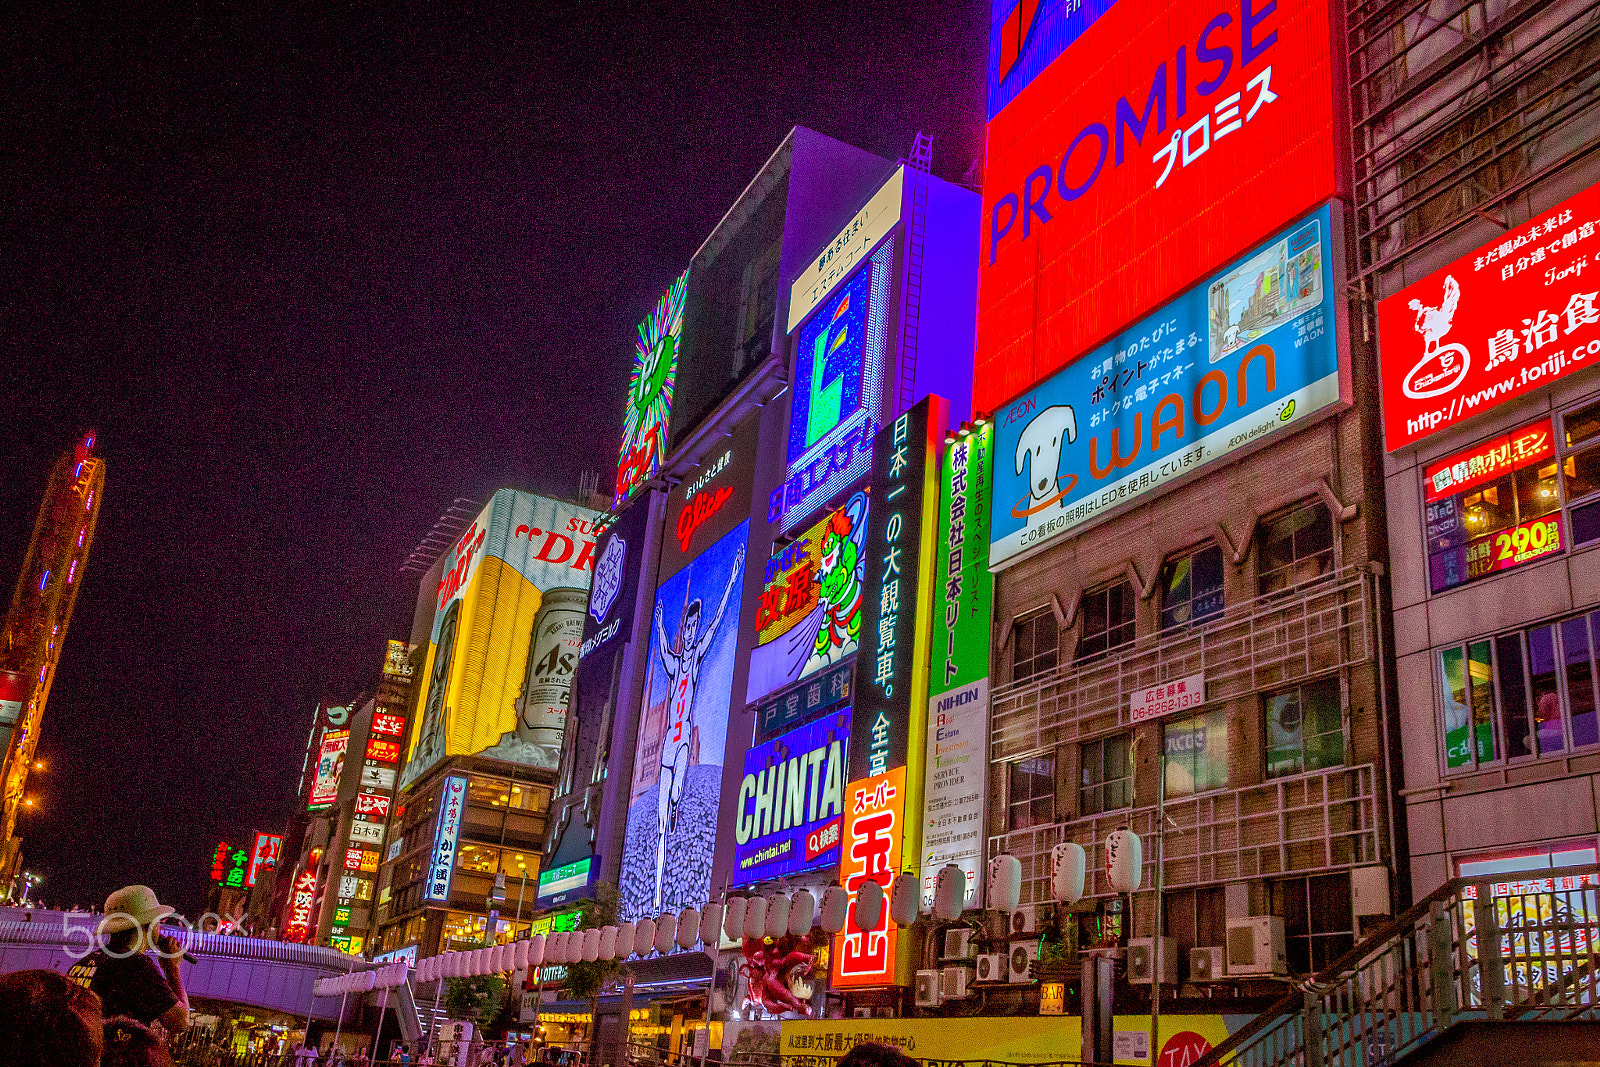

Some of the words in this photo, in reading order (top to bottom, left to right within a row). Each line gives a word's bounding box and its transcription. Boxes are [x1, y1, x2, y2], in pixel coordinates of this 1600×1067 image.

[988, 0, 1279, 267] PROMISE
[1152, 65, 1281, 190] プロミス
[811, 236, 871, 304] エステムコート
[1501, 218, 1600, 281] 自分達で創造
[1091, 318, 1177, 380] お買物のたびに
[1294, 328, 1325, 349] WAON
[1090, 362, 1197, 429] おトクな電子マネー
[686, 450, 732, 500] おいしさと健康
[1451, 431, 1549, 481] 情熱ホルモン
[677, 486, 734, 553] Glico
[1495, 521, 1548, 562] 290
[944, 442, 970, 686] 株式会社日本リート
[754, 563, 813, 633] 改源
[672, 673, 690, 744] グリコ
[937, 687, 979, 714] NIHON
[1145, 681, 1187, 704] 広告募集
[935, 739, 969, 756] Investment
[936, 727, 960, 742] Estate
[853, 780, 898, 815] スーパー
[933, 775, 966, 791] PROVIDER
[1041, 985, 1064, 1000] BAR
